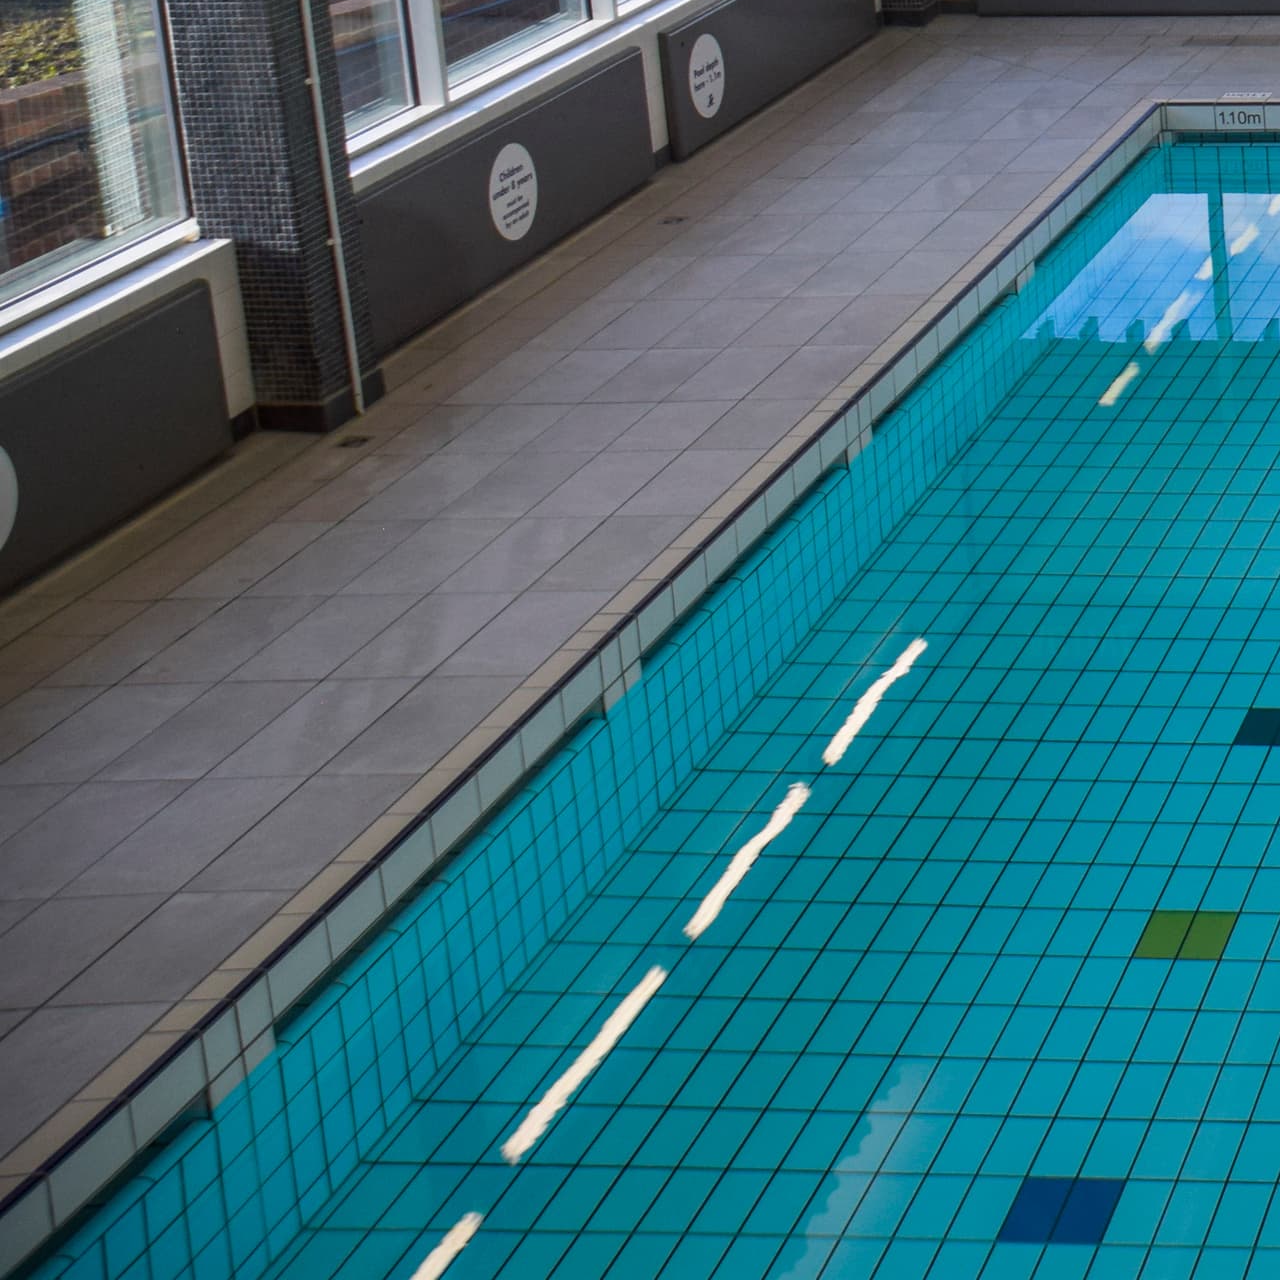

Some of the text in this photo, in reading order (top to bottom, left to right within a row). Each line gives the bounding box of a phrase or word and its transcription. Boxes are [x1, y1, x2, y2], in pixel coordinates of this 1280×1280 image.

[694, 56, 719, 78] Pool depth
[1219, 111, 1261, 125] 1.10m
[499, 164, 523, 182] Children
[493, 186, 509, 200] under
[517, 173, 533, 188] years
